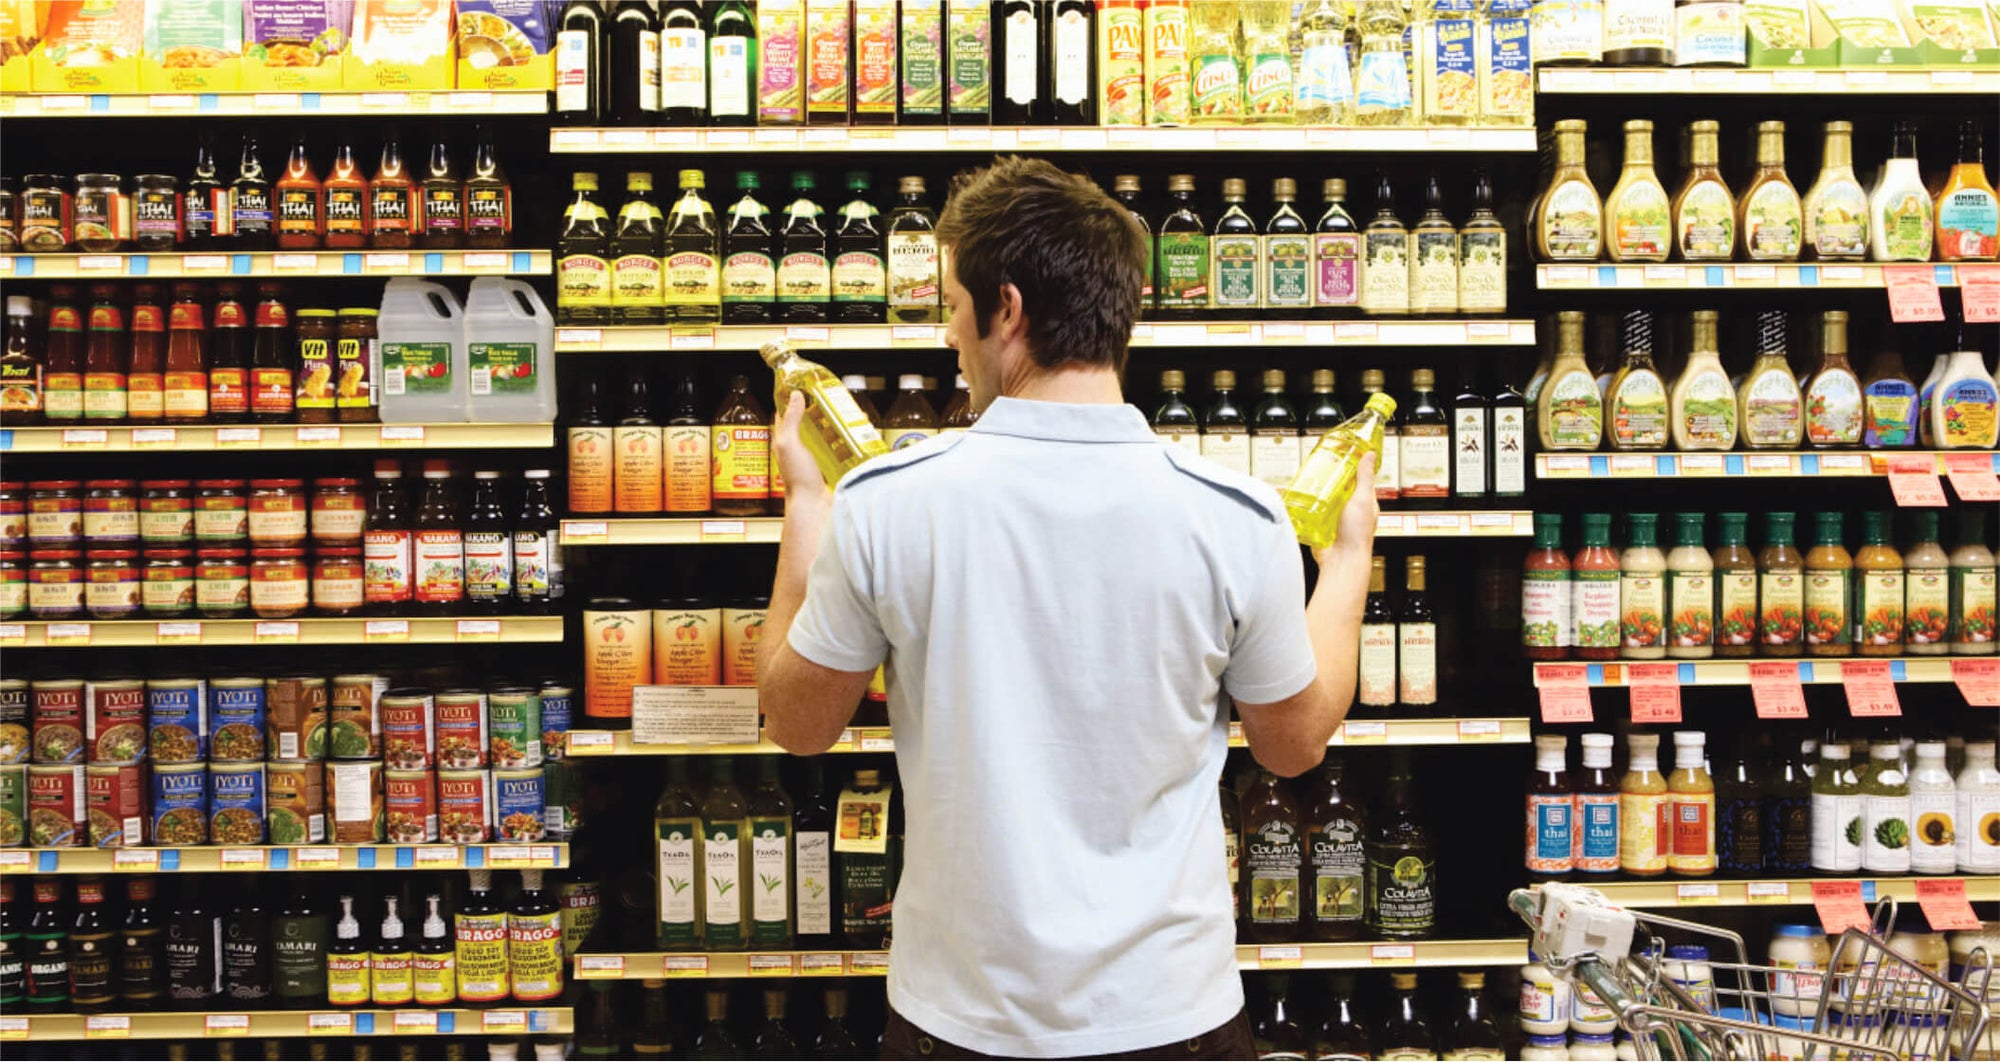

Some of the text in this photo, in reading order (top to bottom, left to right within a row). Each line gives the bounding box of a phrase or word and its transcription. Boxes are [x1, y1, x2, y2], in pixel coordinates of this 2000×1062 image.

[240, 195, 266, 206] THAI
[27, 204, 52, 217] THAI
[138, 202, 173, 215] THAI
[281, 203, 314, 215] THAI
[327, 203, 360, 215] THAI
[373, 203, 406, 215] THAI
[427, 203, 461, 215] THAI
[469, 202, 503, 214] THAI
[303, 342, 325, 356] VH
[2, 364, 30, 377] Thai
[423, 534, 461, 543] NAKANO
[1544, 827, 1568, 838] thai
[1590, 826, 1613, 837] thai
[1250, 844, 1300, 855] COLAVITA
[1314, 842, 1364, 854] COLAVITA
[1384, 887, 1431, 900] COLAVITA
[570, 896, 598, 908] BRA
[457, 928, 504, 941] BRAGG
[510, 928, 555, 941] BRAGG
